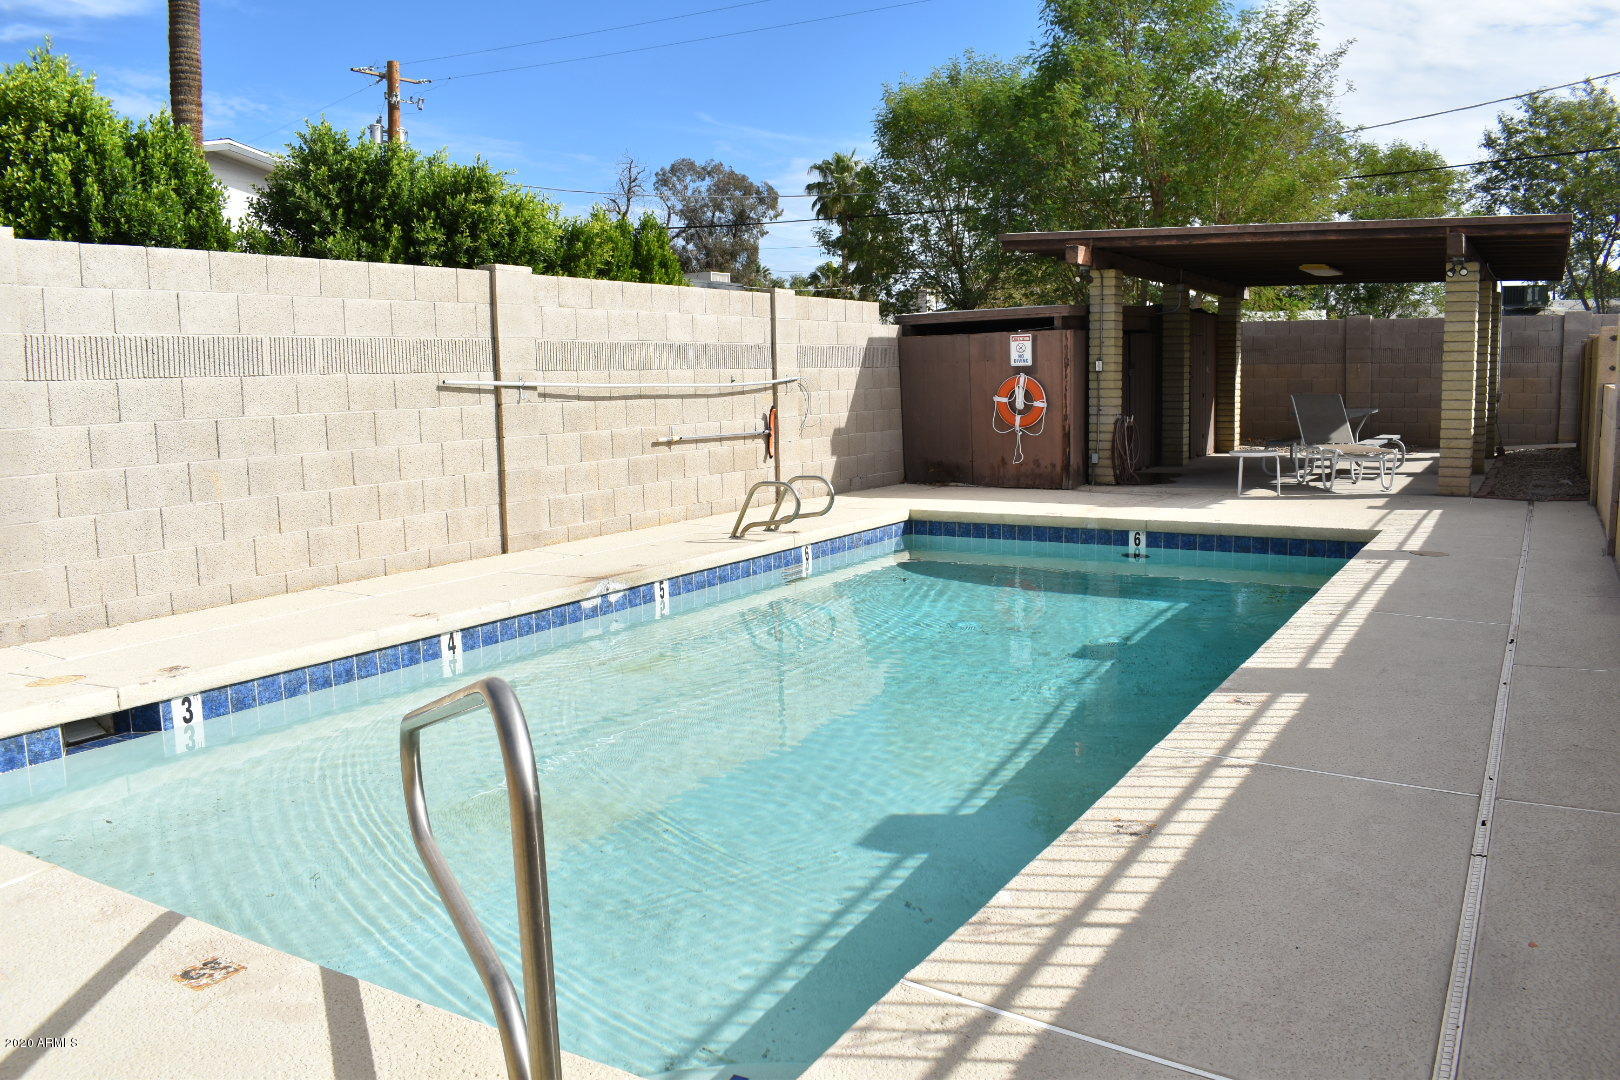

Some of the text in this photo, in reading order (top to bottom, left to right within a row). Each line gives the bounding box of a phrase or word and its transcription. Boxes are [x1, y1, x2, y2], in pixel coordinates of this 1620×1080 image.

[1133, 531, 1141, 547] 6
[659, 580, 665, 600] 5
[447, 632, 457, 655] 4
[181, 696, 194, 724] 3
